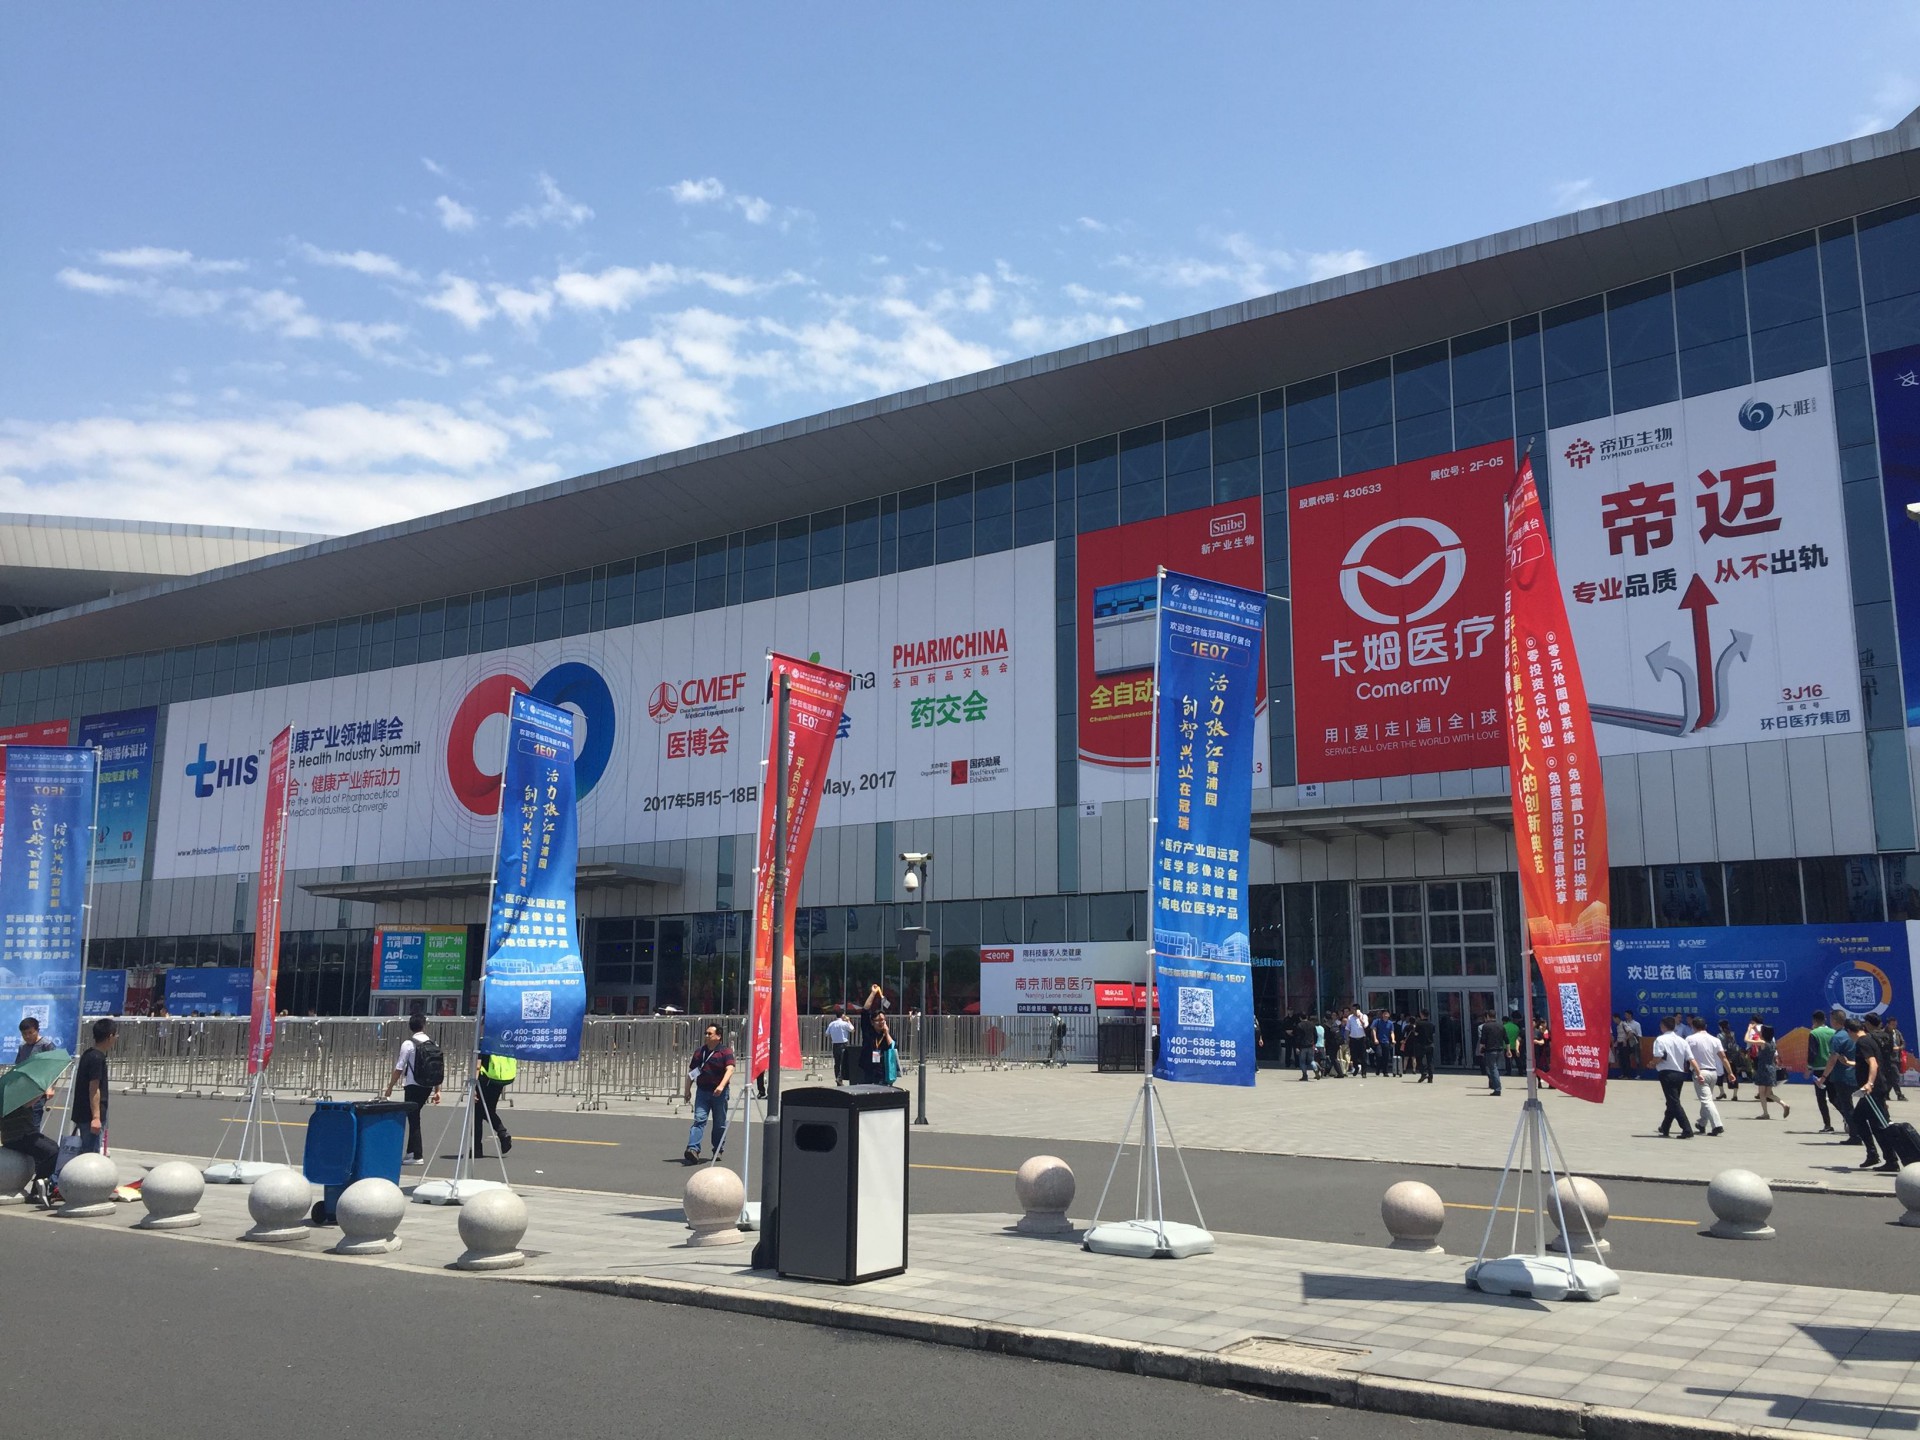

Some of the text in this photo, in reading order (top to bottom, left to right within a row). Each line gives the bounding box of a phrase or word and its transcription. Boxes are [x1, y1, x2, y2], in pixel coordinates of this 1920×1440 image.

[1600, 427, 1672, 454] 帝迈生物
[1601, 441, 1673, 461] DYMIND BIOTECH
[1601, 460, 1783, 557] 帝迈
[1212, 520, 1243, 533] Snibe
[1201, 534, 1254, 555] 新产业生物
[1714, 544, 1829, 584] 从不出轨
[1572, 568, 1678, 604] 专业品质
[1169, 621, 1252, 648] 欢迎您莅临冠瑞医疗展台
[1321, 615, 1496, 677] 卡姆医疗
[892, 628, 1009, 669] PHARMCHINA
[1191, 641, 1229, 660] 1E07
[892, 662, 1009, 689] 全国药品交易会
[681, 672, 747, 706] CMEF
[1356, 676, 1451, 700] Comermy
[1526, 649, 1556, 749] 零投资合伙创业
[1782, 684, 1823, 701] 3J16
[685, 711, 706, 719] Medical
[707, 708, 734, 718] Equipment
[910, 689, 988, 729] 药交会
[1089, 710, 1154, 723] Chemiluminescenc
[1760, 709, 1851, 730] 环日医疗集团
[797, 713, 819, 730] 1E07
[533, 743, 557, 759] 1E07
[667, 725, 729, 760] 医博会
[1204, 672, 1230, 807] 活力张江青浦园
[1325, 730, 1500, 756] SERVICE ALL OVER THE WORLD WITH LOVE
[299, 741, 421, 768] Health Industry Summit
[1178, 694, 1198, 831] 创智兴业在冠瑞
[859, 770, 896, 791] 2017
[297, 789, 400, 805] the World of Pharmaceutical
[317, 804, 350, 815] Industries
[352, 801, 389, 813] Converge
[643, 786, 758, 812] 2017年5月15-18日
[537, 767, 561, 870] 活力张江青浦园
[1548, 771, 1568, 905] 免费医院设备信息共享
[1568, 768, 1588, 902] 免费赢DR以旧换新
[1164, 838, 1239, 863] 医疗产业园运营
[1163, 858, 1238, 882] 医学影像设备
[1162, 877, 1238, 901] 医院投资管理
[505, 893, 566, 910] 医疗产业园运营
[1161, 897, 1239, 921] 高电位医学产品
[503, 908, 566, 924] 医学影像设备
[444, 936, 463, 945] 广州
[1582, 954, 1602, 962] 1E07
[1226, 974, 1246, 983] 1E07
[1627, 964, 1692, 980] 欢迎莅临
[1703, 969, 1780, 980] 冠瑞医疗 1E07
[1170, 1036, 1236, 1049] 400-6366-888
[1170, 1046, 1236, 1058] 400-0985-999
